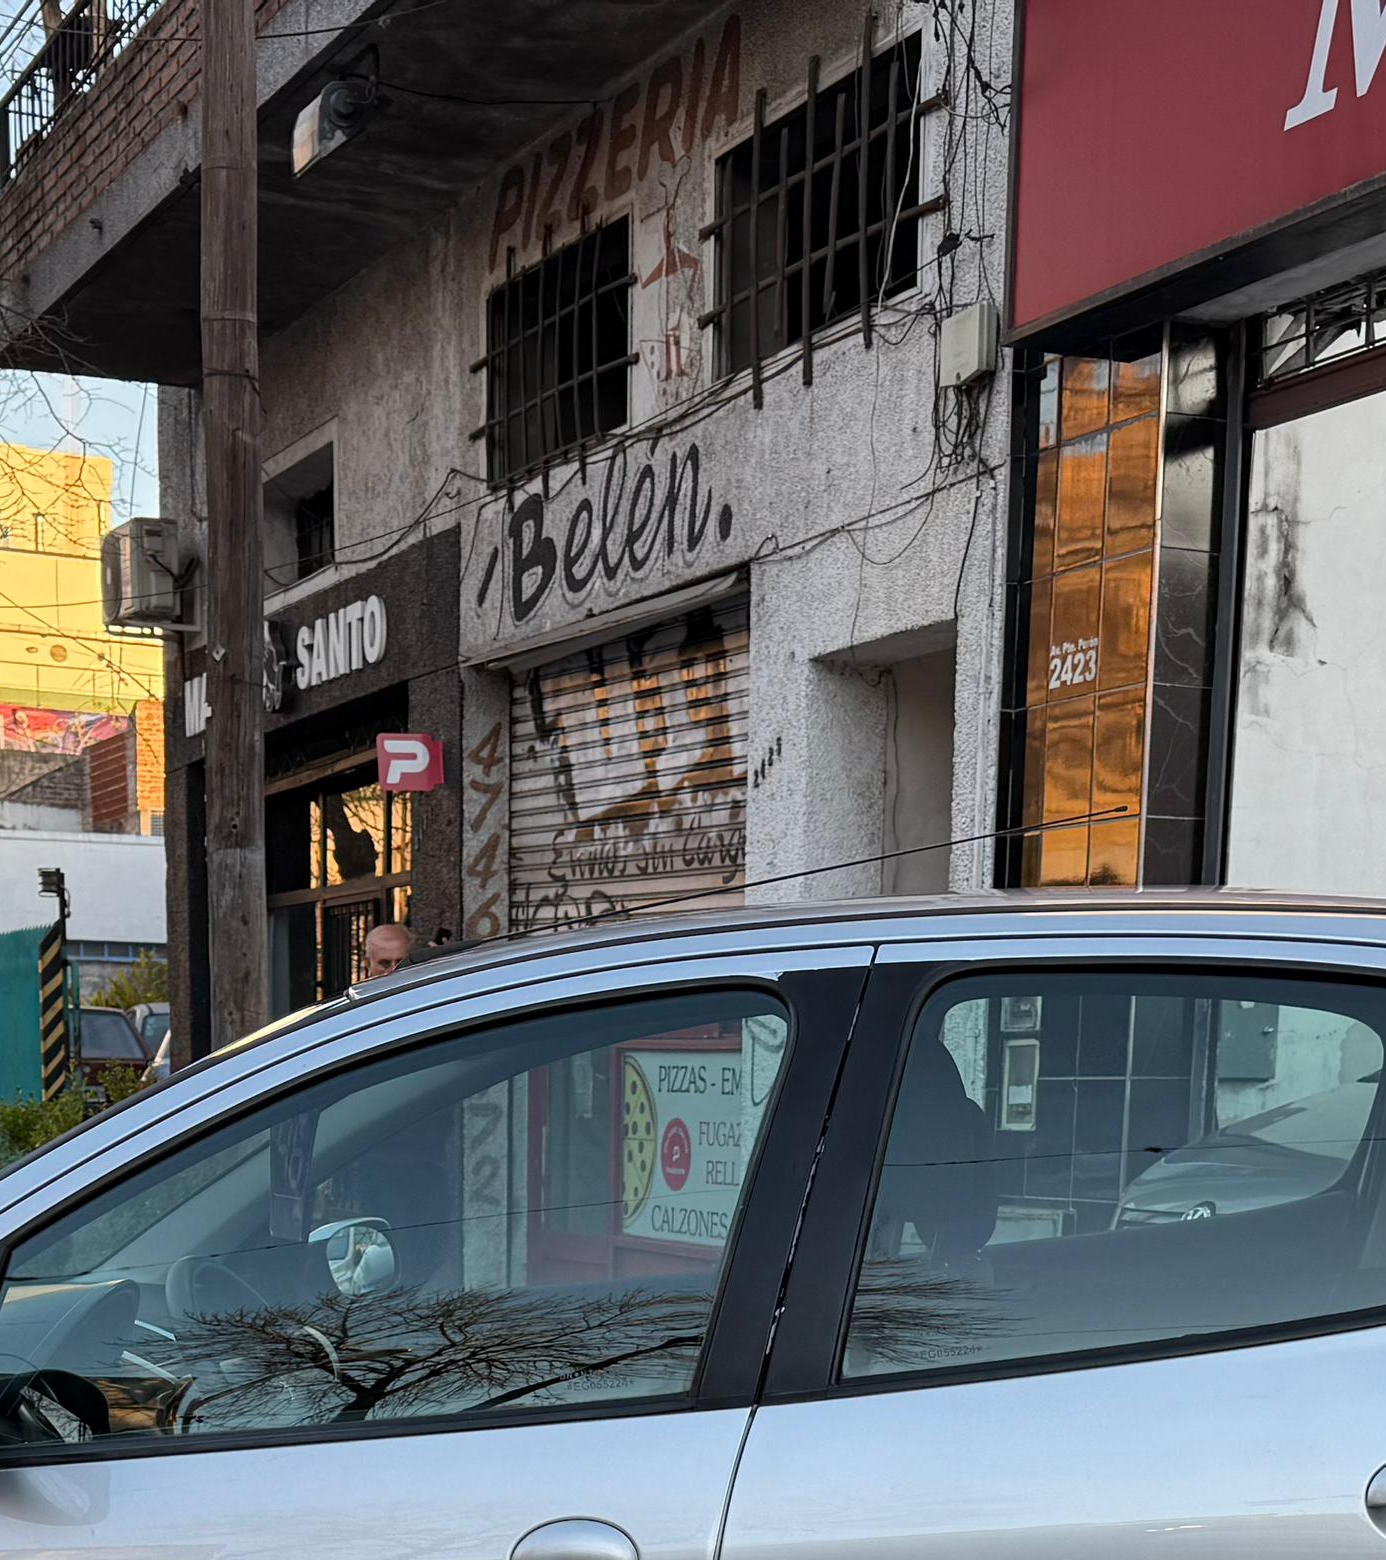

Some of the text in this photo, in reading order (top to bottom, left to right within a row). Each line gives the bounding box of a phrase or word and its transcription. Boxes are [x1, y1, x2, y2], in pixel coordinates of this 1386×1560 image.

[488, 13, 742, 274] PIZZERIA
[296, 594, 387, 690] SANTO
[1049, 650, 1097, 690] 2423
[658, 1065, 706, 1094] PIZZAS
[651, 1204, 728, 1240] CALZONES
